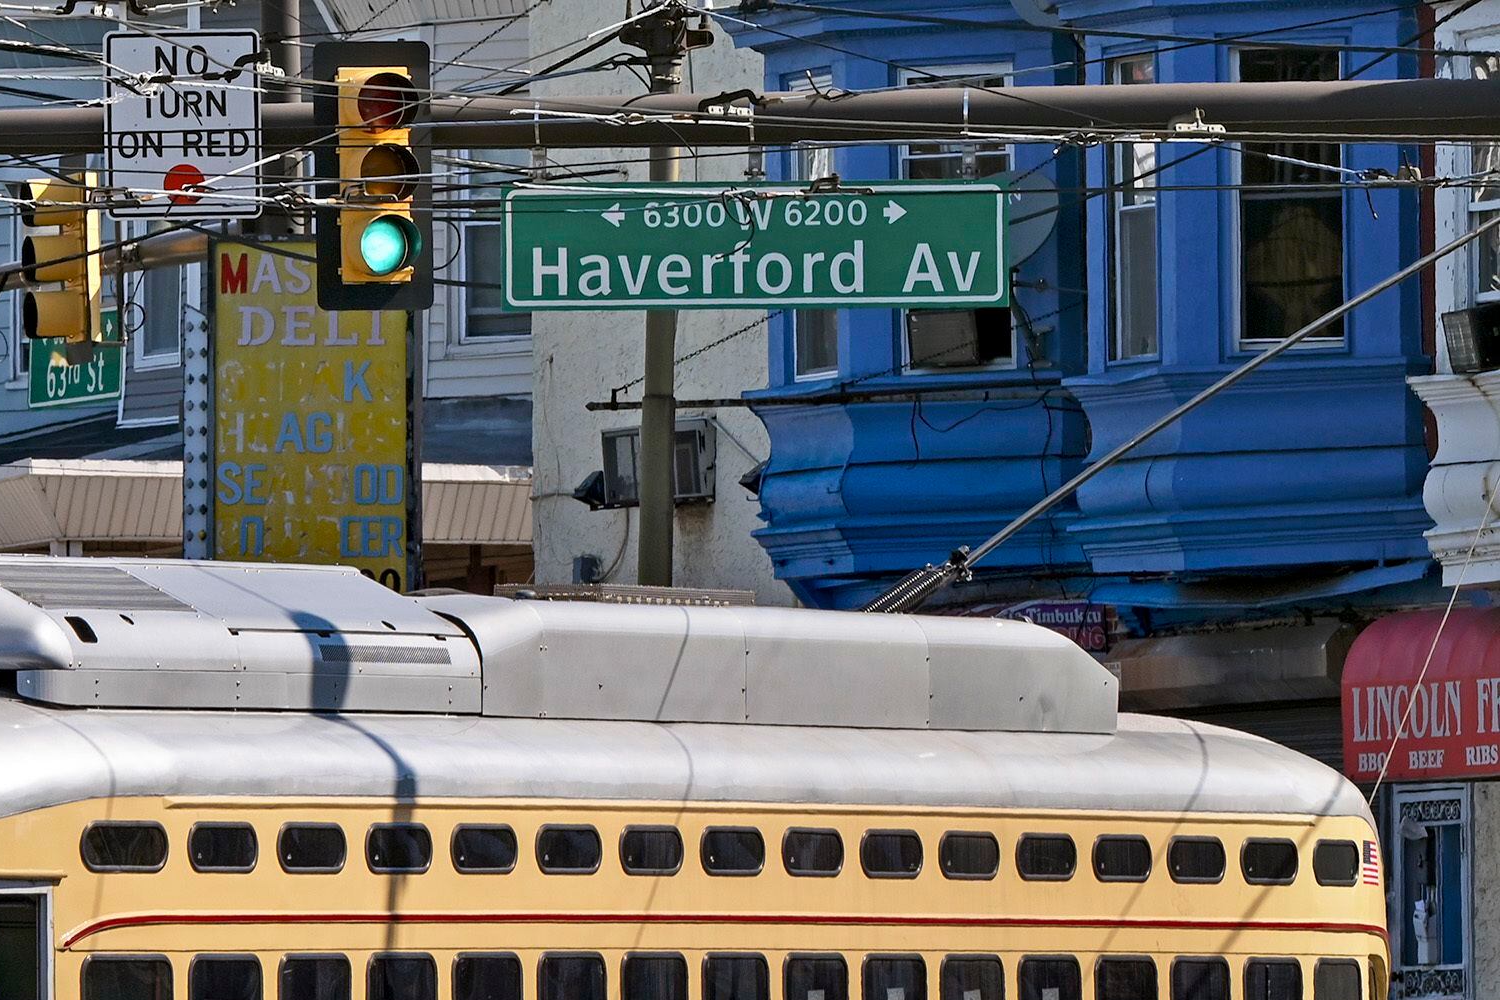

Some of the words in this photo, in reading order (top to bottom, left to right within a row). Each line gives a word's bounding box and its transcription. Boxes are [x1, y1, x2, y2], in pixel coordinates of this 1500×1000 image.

[155, 45, 209, 75] NO
[118, 132, 163, 158] ON
[182, 131, 249, 157] RED
[643, 201, 725, 229] 6300
[736, 199, 773, 231] W
[785, 200, 867, 227] 6200
[532, 240, 864, 296] Haverford
[902, 243, 981, 293] Av
[237, 306, 386, 346] DELI
[87, 352, 105, 393] St
[1352, 681, 1462, 742] LINCOLN
[1358, 752, 1388, 777] BBQ
[1409, 749, 1445, 769] BEEF
[1466, 744, 1499, 766] RIBS
